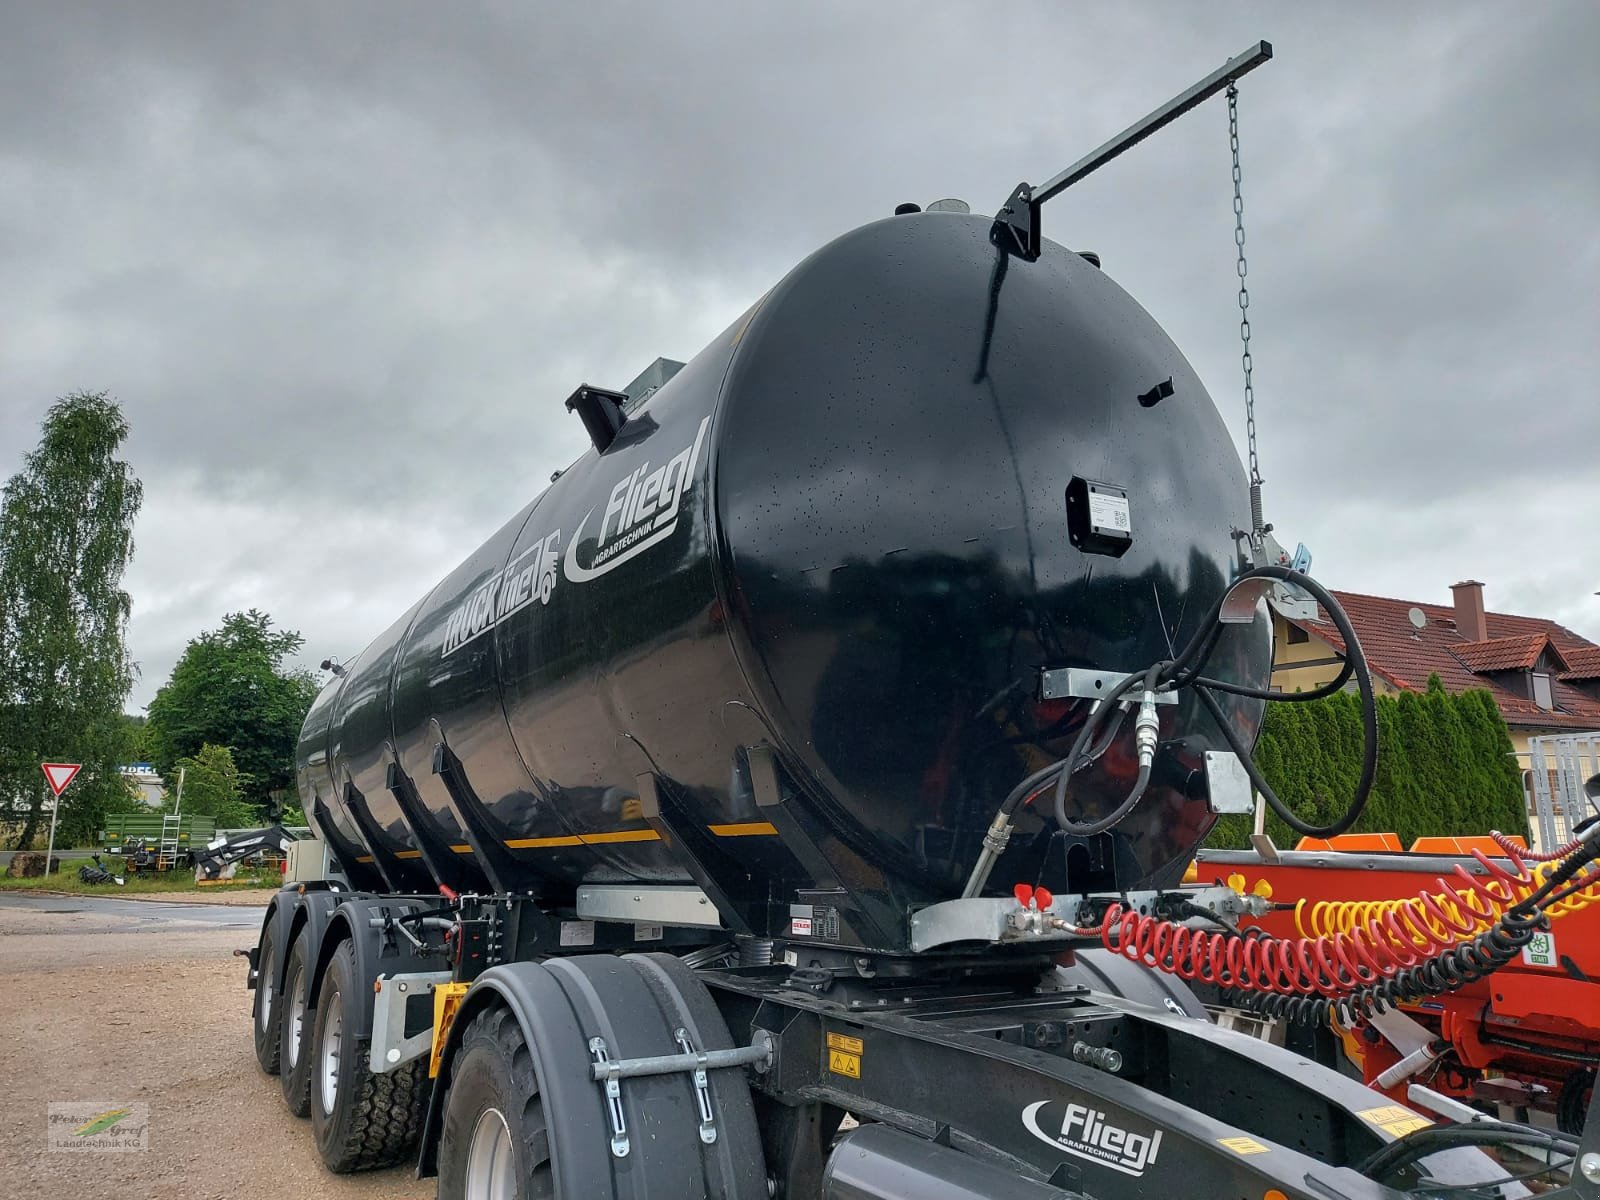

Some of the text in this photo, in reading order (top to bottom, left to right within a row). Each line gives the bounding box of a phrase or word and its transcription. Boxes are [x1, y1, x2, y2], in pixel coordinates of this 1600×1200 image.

[598, 416, 710, 548] Fliegl
[594, 520, 653, 566] AGRARTECHNIK
[1058, 1136, 1119, 1162] AGRARTECHNIK
[1061, 1103, 1162, 1170] Fliegl
